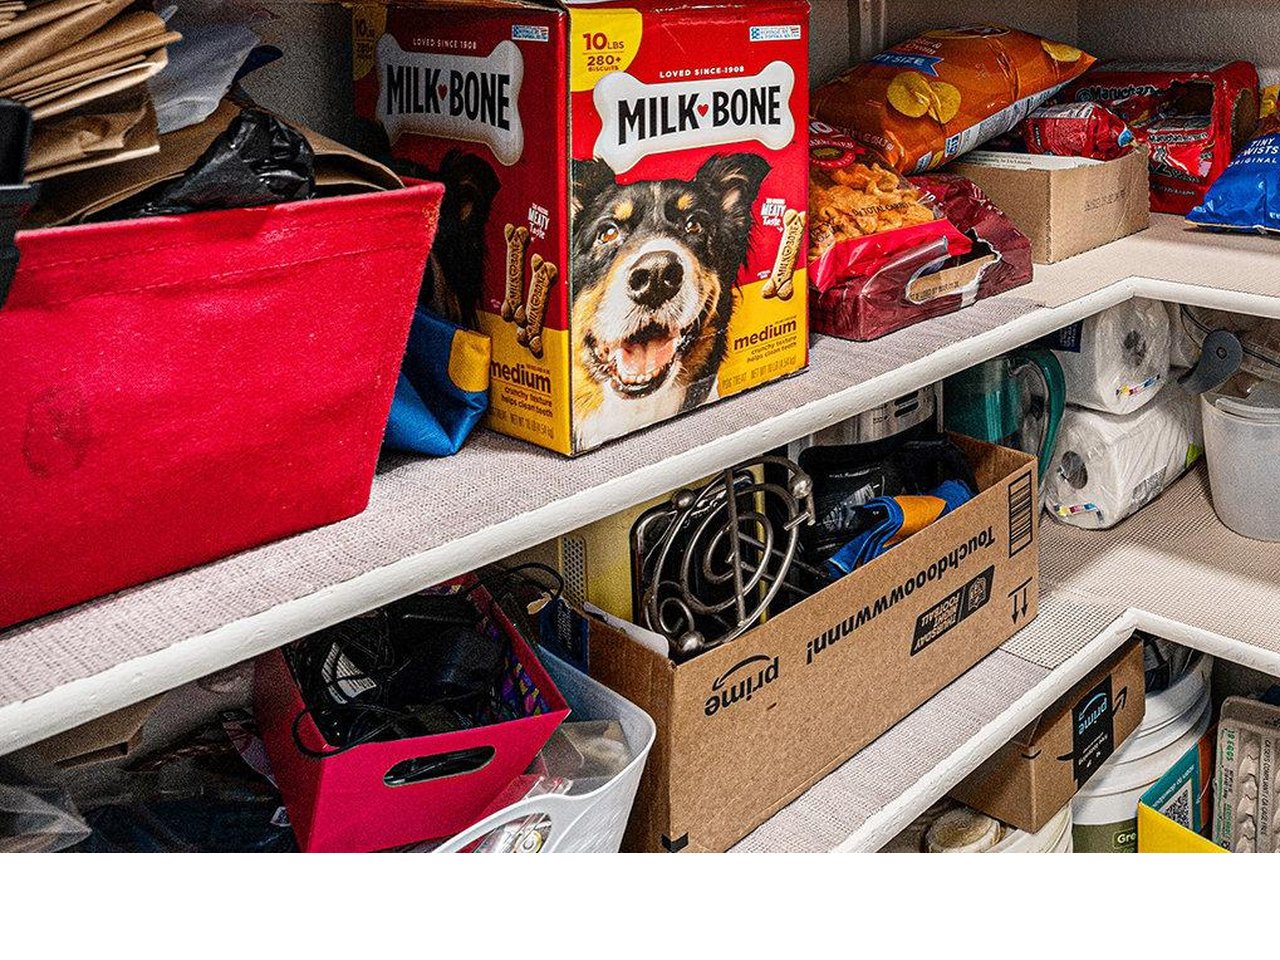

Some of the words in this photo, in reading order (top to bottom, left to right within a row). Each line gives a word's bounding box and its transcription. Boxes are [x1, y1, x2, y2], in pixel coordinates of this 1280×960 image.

[413, 38, 435, 47] LOVED
[436, 39, 458, 48] SINCE
[460, 40, 477, 50] 1908
[582, 32, 608, 50] 10
[607, 41, 625, 50] LBS
[587, 54, 621, 66] 280+
[659, 68, 691, 79] LOVED
[694, 68, 721, 76] SINCE
[724, 65, 745, 74] 1908
[386, 64, 441, 115] MILK
[449, 70, 511, 131] BONE
[617, 92, 700, 146] MILK
[712, 85, 781, 128] BONE
[1251, 137, 1275, 147] TINY
[1238, 146, 1279, 157] WISTS
[528, 207, 550, 230] MEATY
[734, 319, 797, 351] medium
[751, 343, 774, 355] crunchy
[747, 353, 763, 363] helps
[703, 655, 780, 717] prime
[1078, 697, 1108, 735] prime
